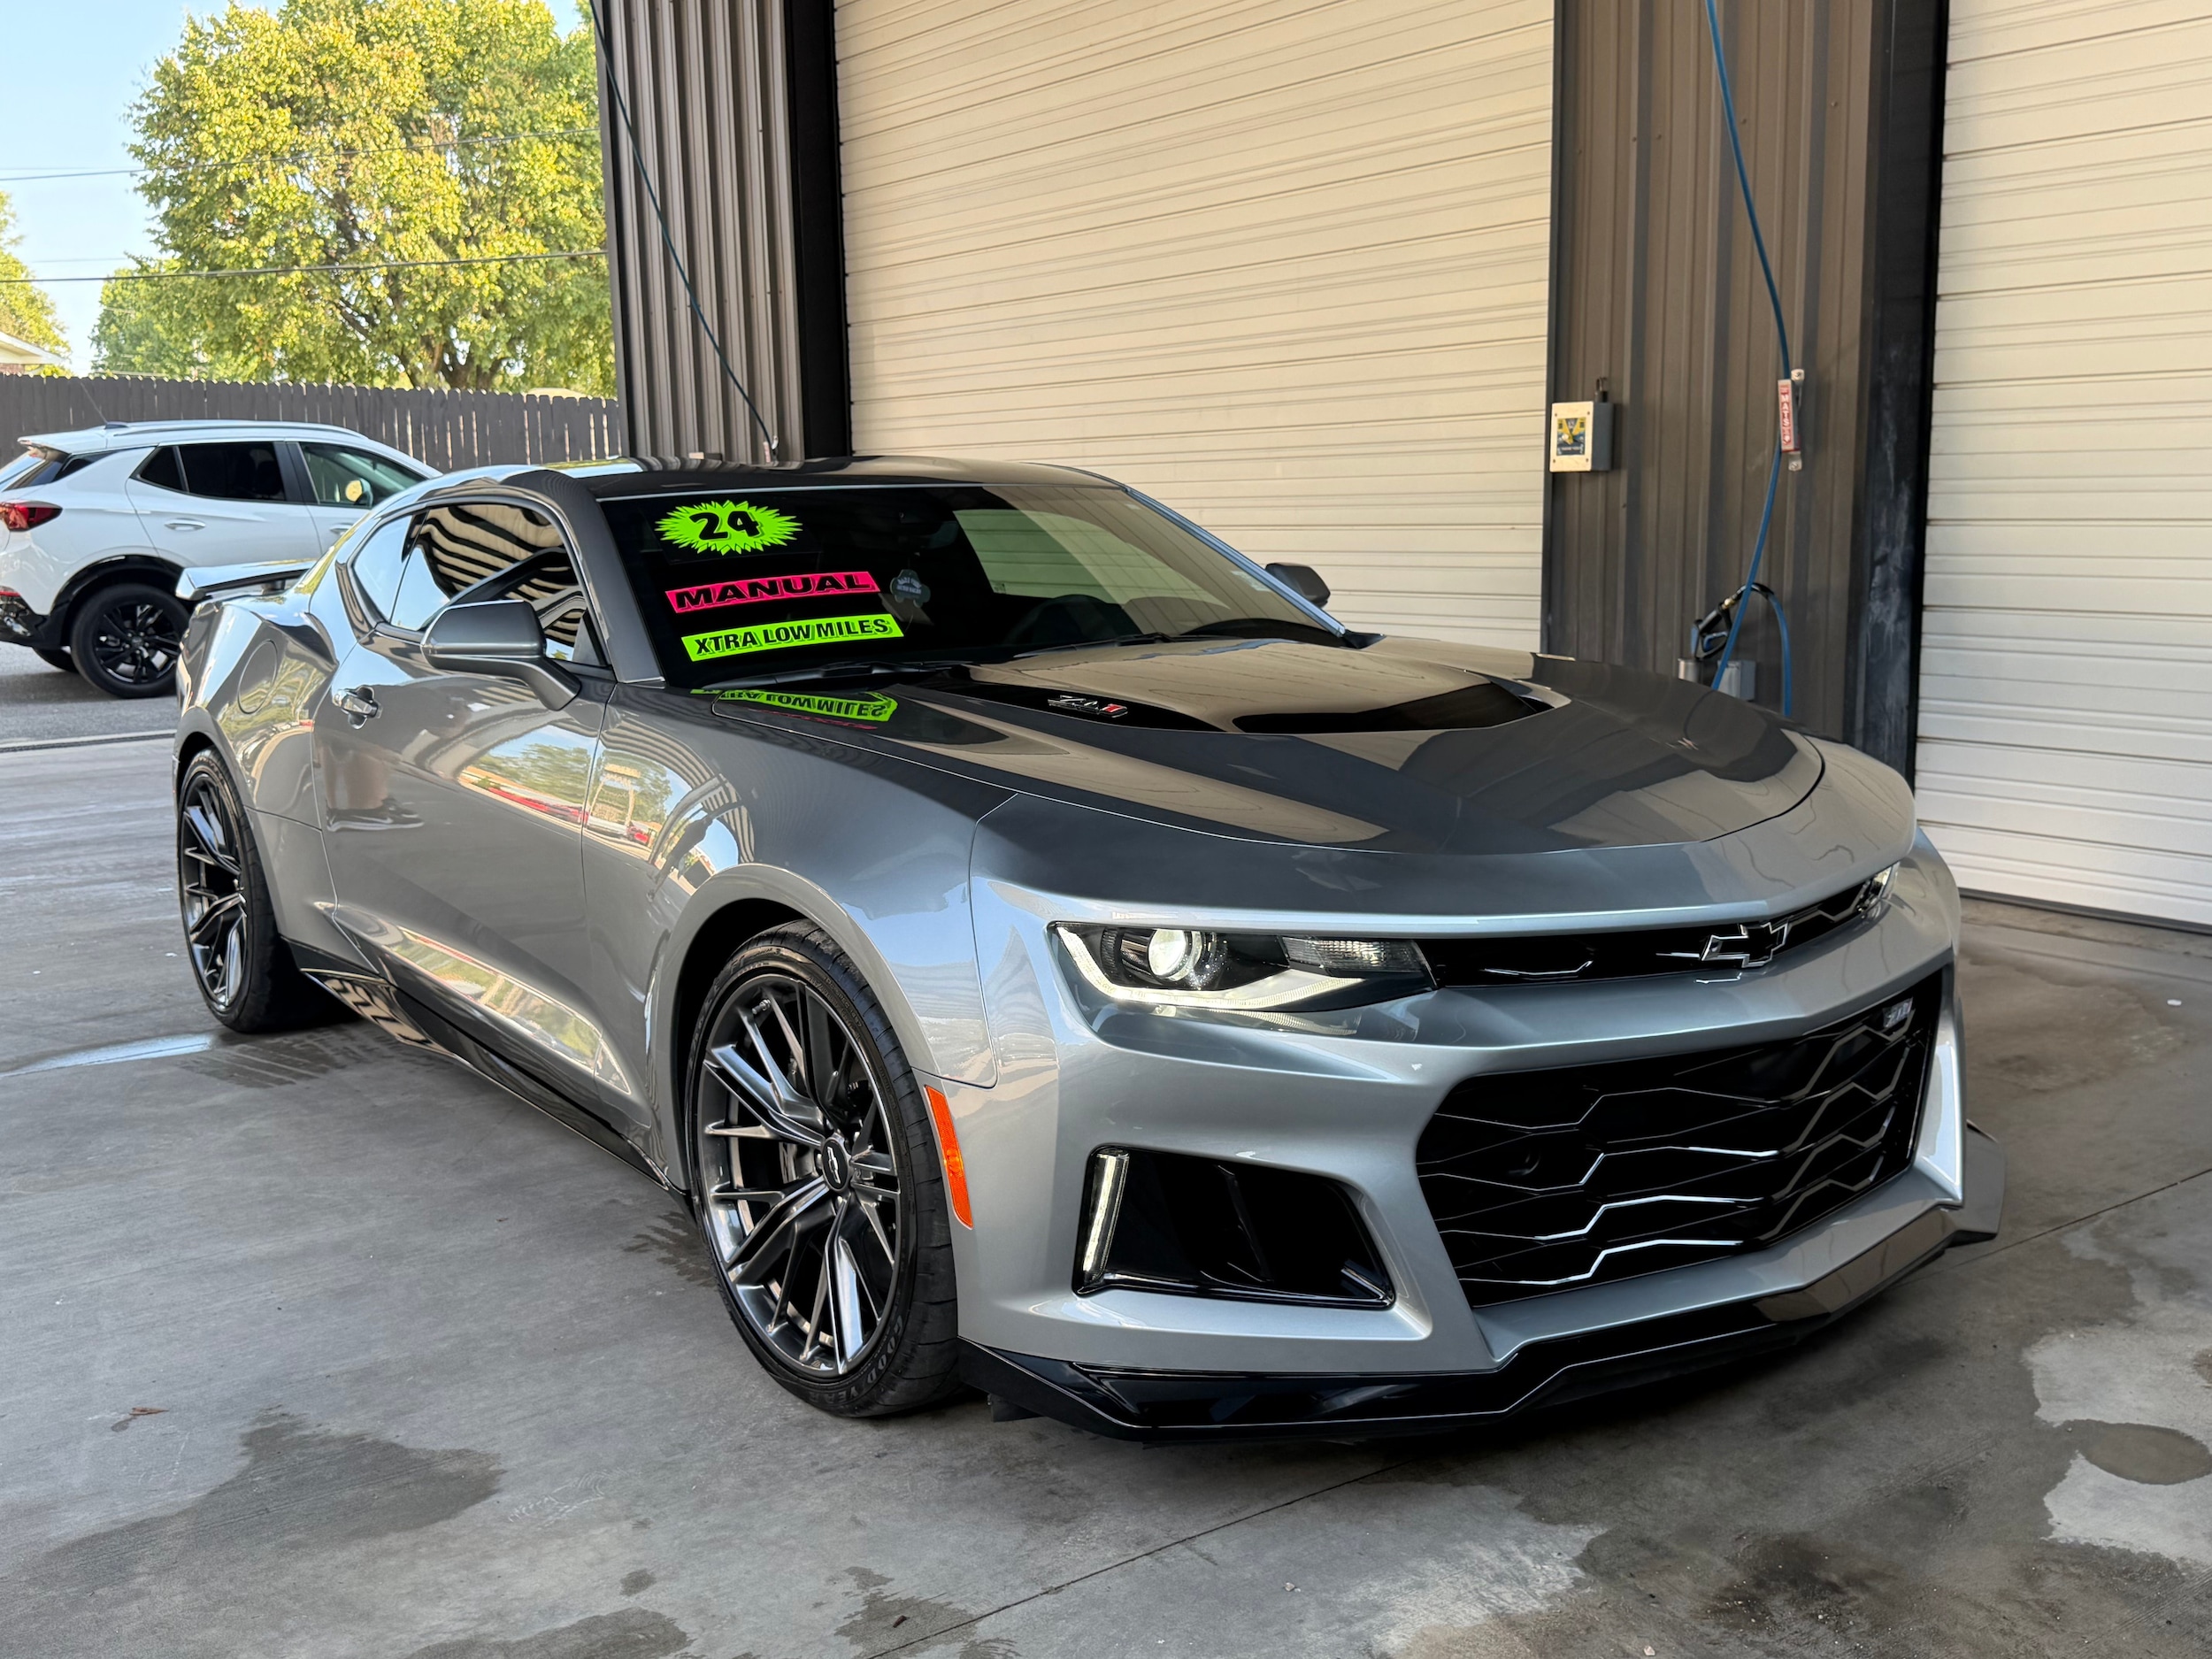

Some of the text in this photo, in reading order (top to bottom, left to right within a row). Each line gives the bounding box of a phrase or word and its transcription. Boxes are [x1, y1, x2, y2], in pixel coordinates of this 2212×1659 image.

[689, 511, 761, 541] 24
[675, 573, 872, 609] MANUAL
[696, 618, 891, 656] XTRA LOW MILES
